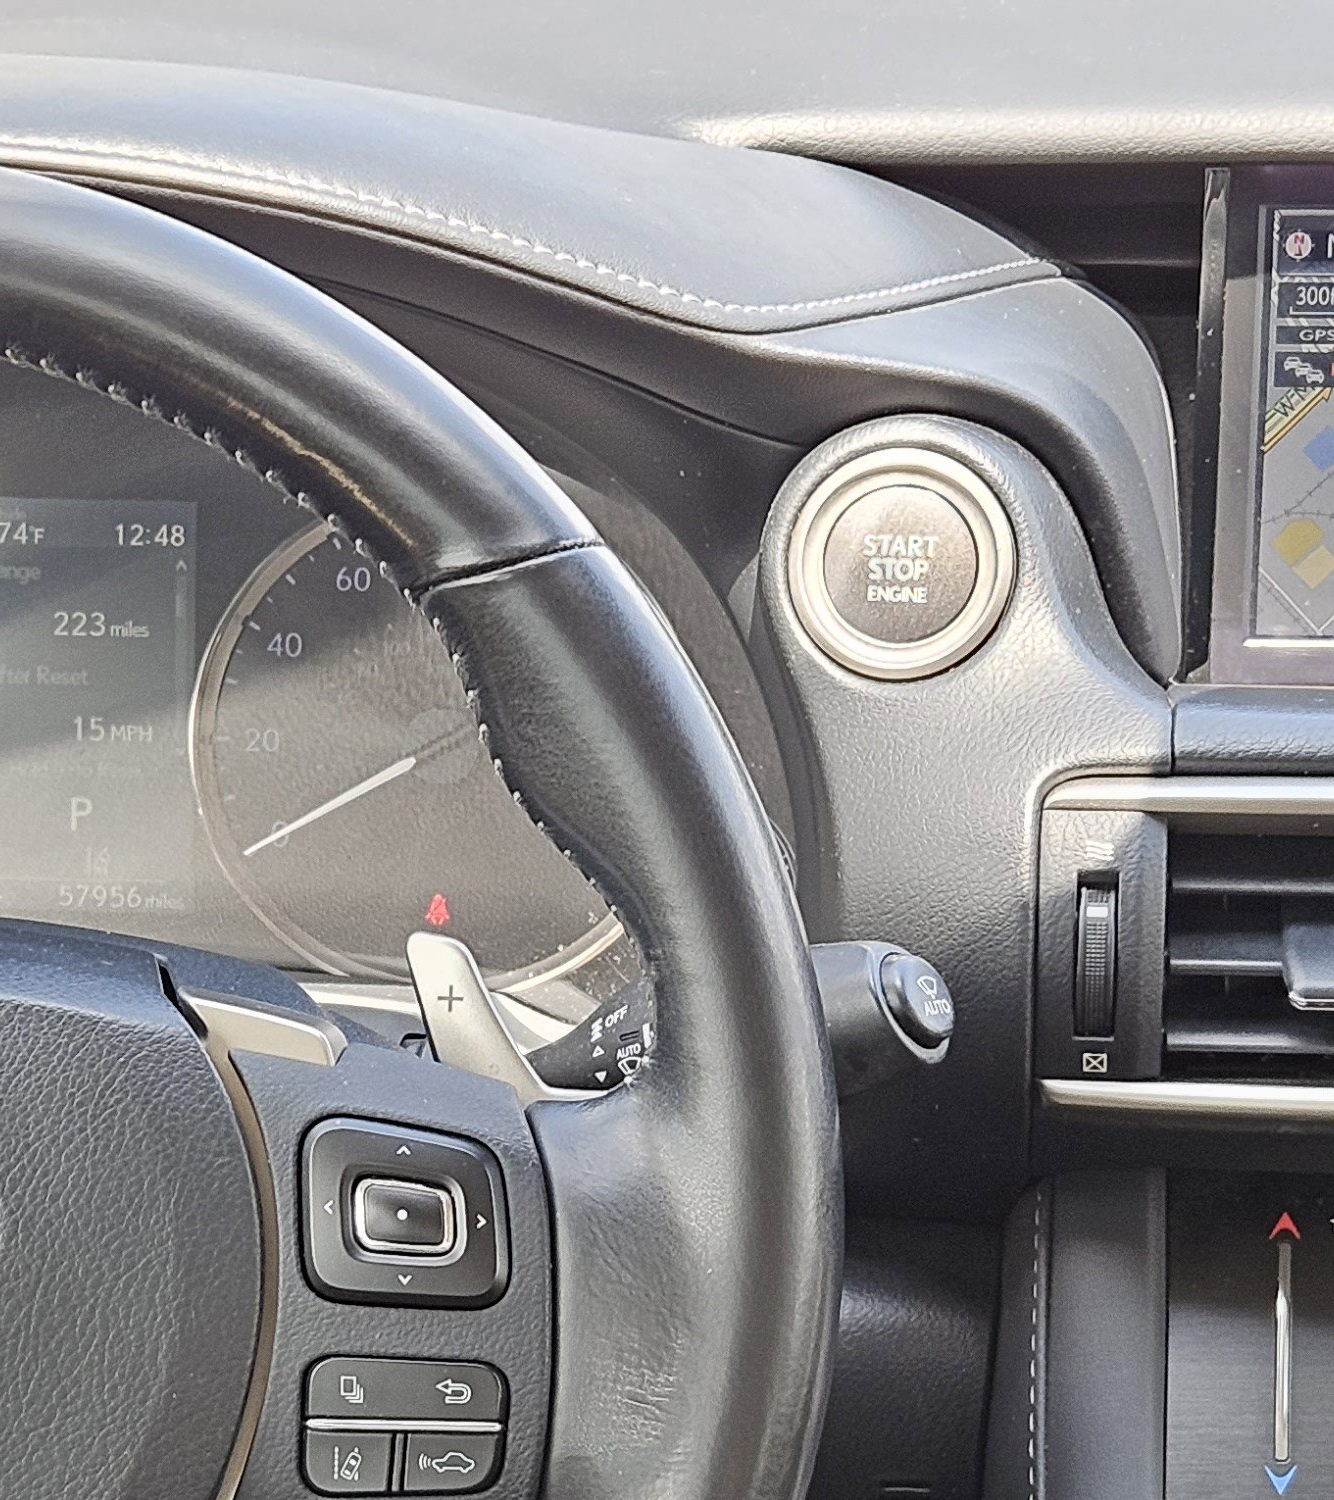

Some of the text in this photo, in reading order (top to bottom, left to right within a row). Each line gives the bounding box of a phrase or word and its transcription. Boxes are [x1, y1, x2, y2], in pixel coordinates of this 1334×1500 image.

[115, 523, 186, 547] 12:48
[863, 534, 939, 558] START
[335, 566, 371, 592] 60
[867, 557, 929, 581] STOP
[867, 586, 928, 604] ENGINE
[53, 611, 150, 639] 223 miles
[267, 632, 303, 658] 40
[74, 716, 153, 742] 15 MPH
[246, 728, 280, 752] 20
[70, 796, 93, 832] P
[59, 884, 142, 908] 57956
[605, 1004, 628, 1028] OFF
[924, 1000, 951, 1016] AUTO
[616, 1043, 642, 1060] AUTO
